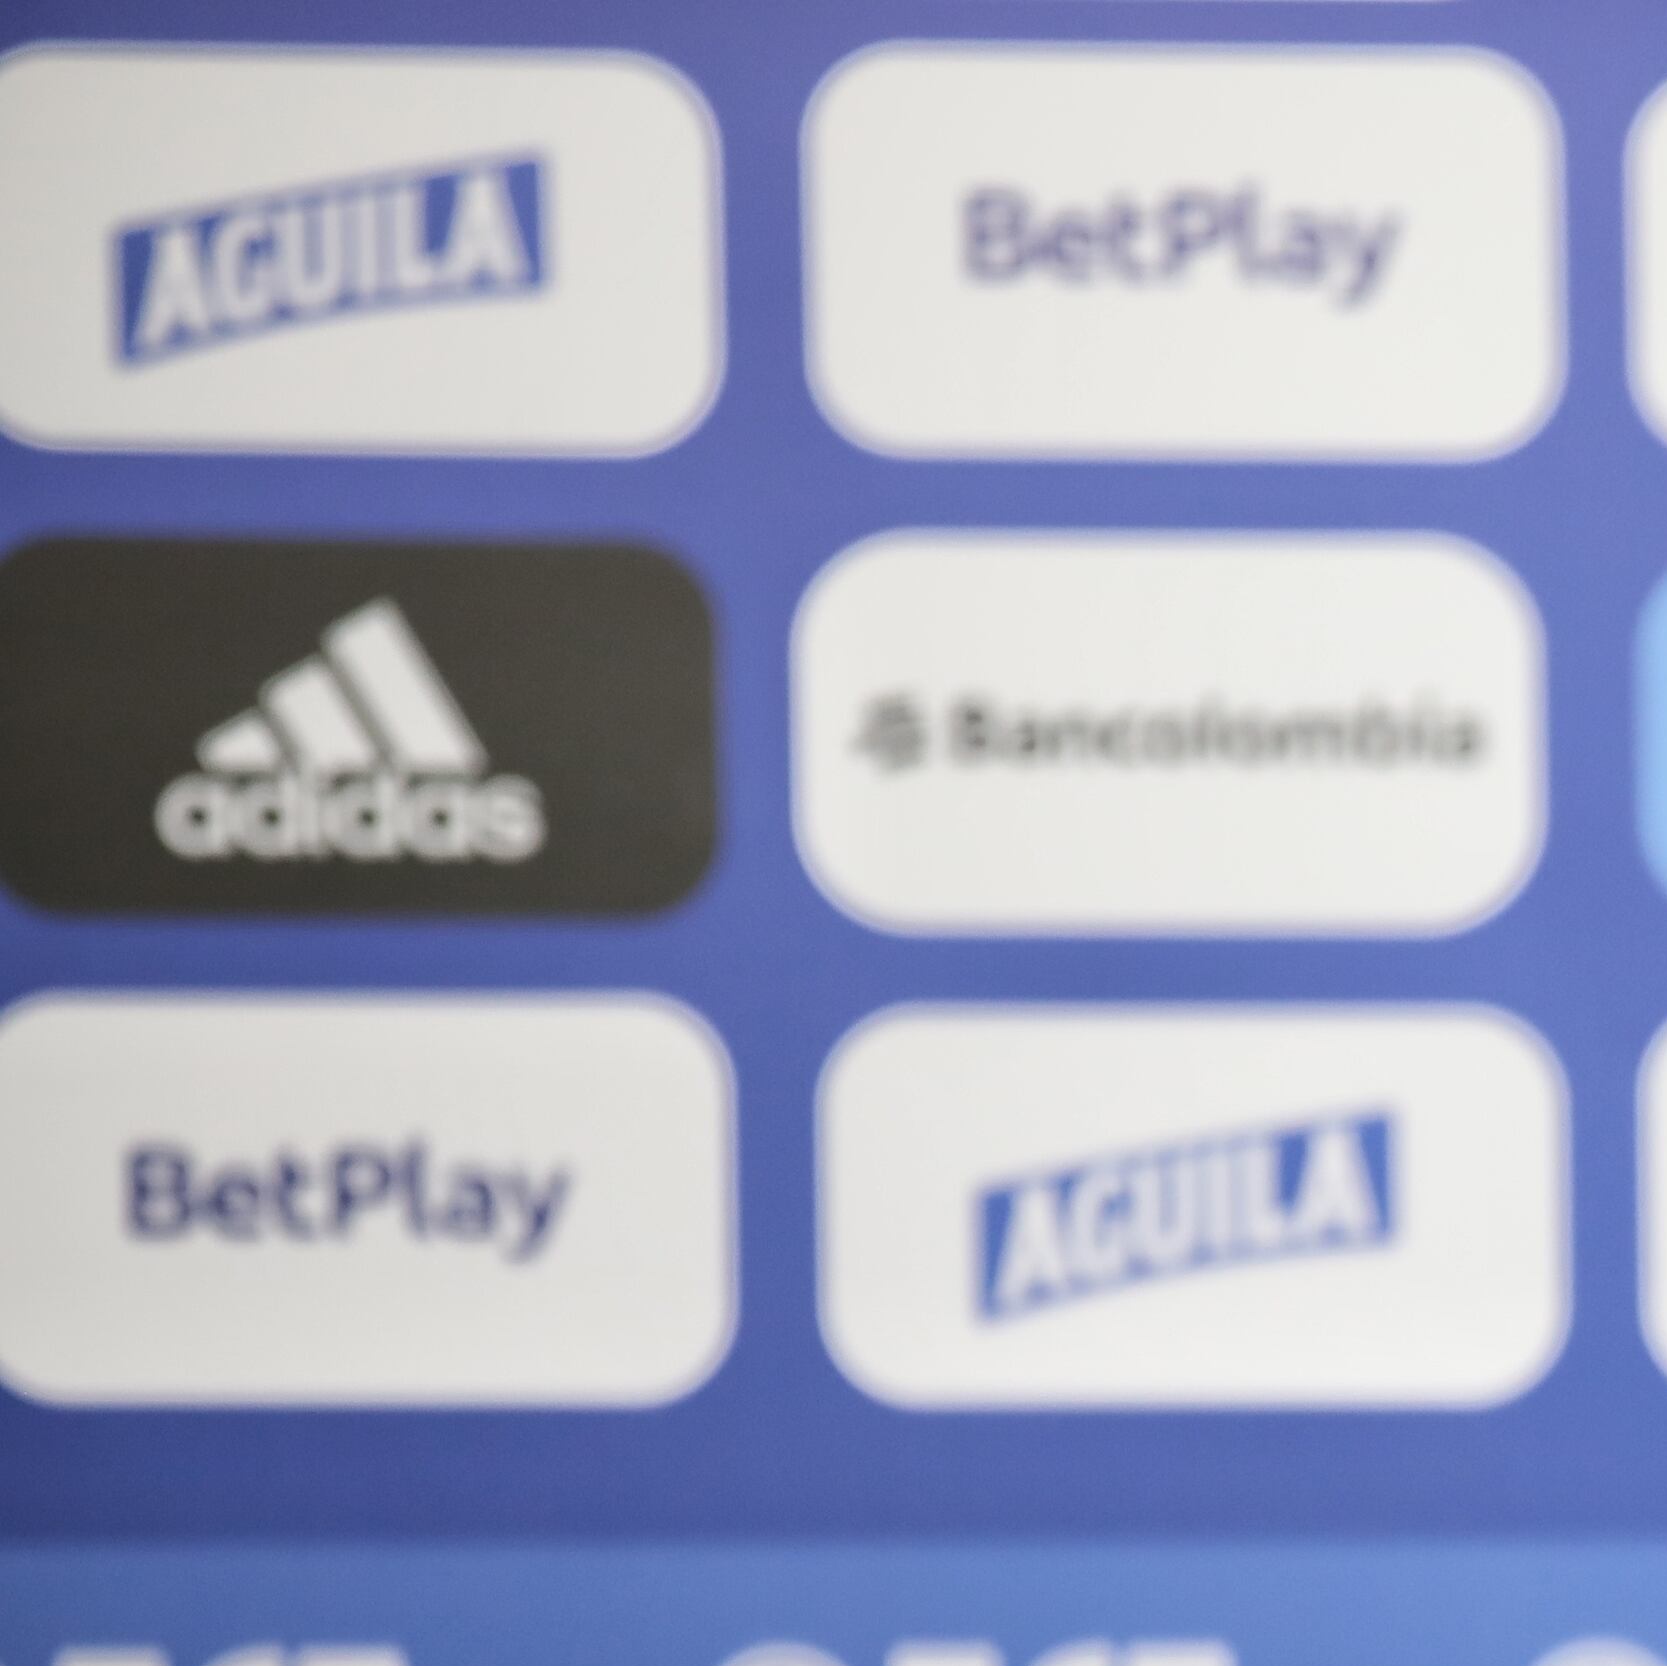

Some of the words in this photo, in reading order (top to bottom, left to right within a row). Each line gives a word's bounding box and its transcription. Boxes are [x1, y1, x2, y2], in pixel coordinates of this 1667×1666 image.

[130, 165, 537, 350] AGUILA
[962, 182, 1400, 310] BetPlay
[950, 690, 1488, 765] Bancolombia
[154, 762, 547, 862] adidas
[122, 1138, 573, 1267] BetPlay
[995, 1122, 1392, 1308] AGUILA
